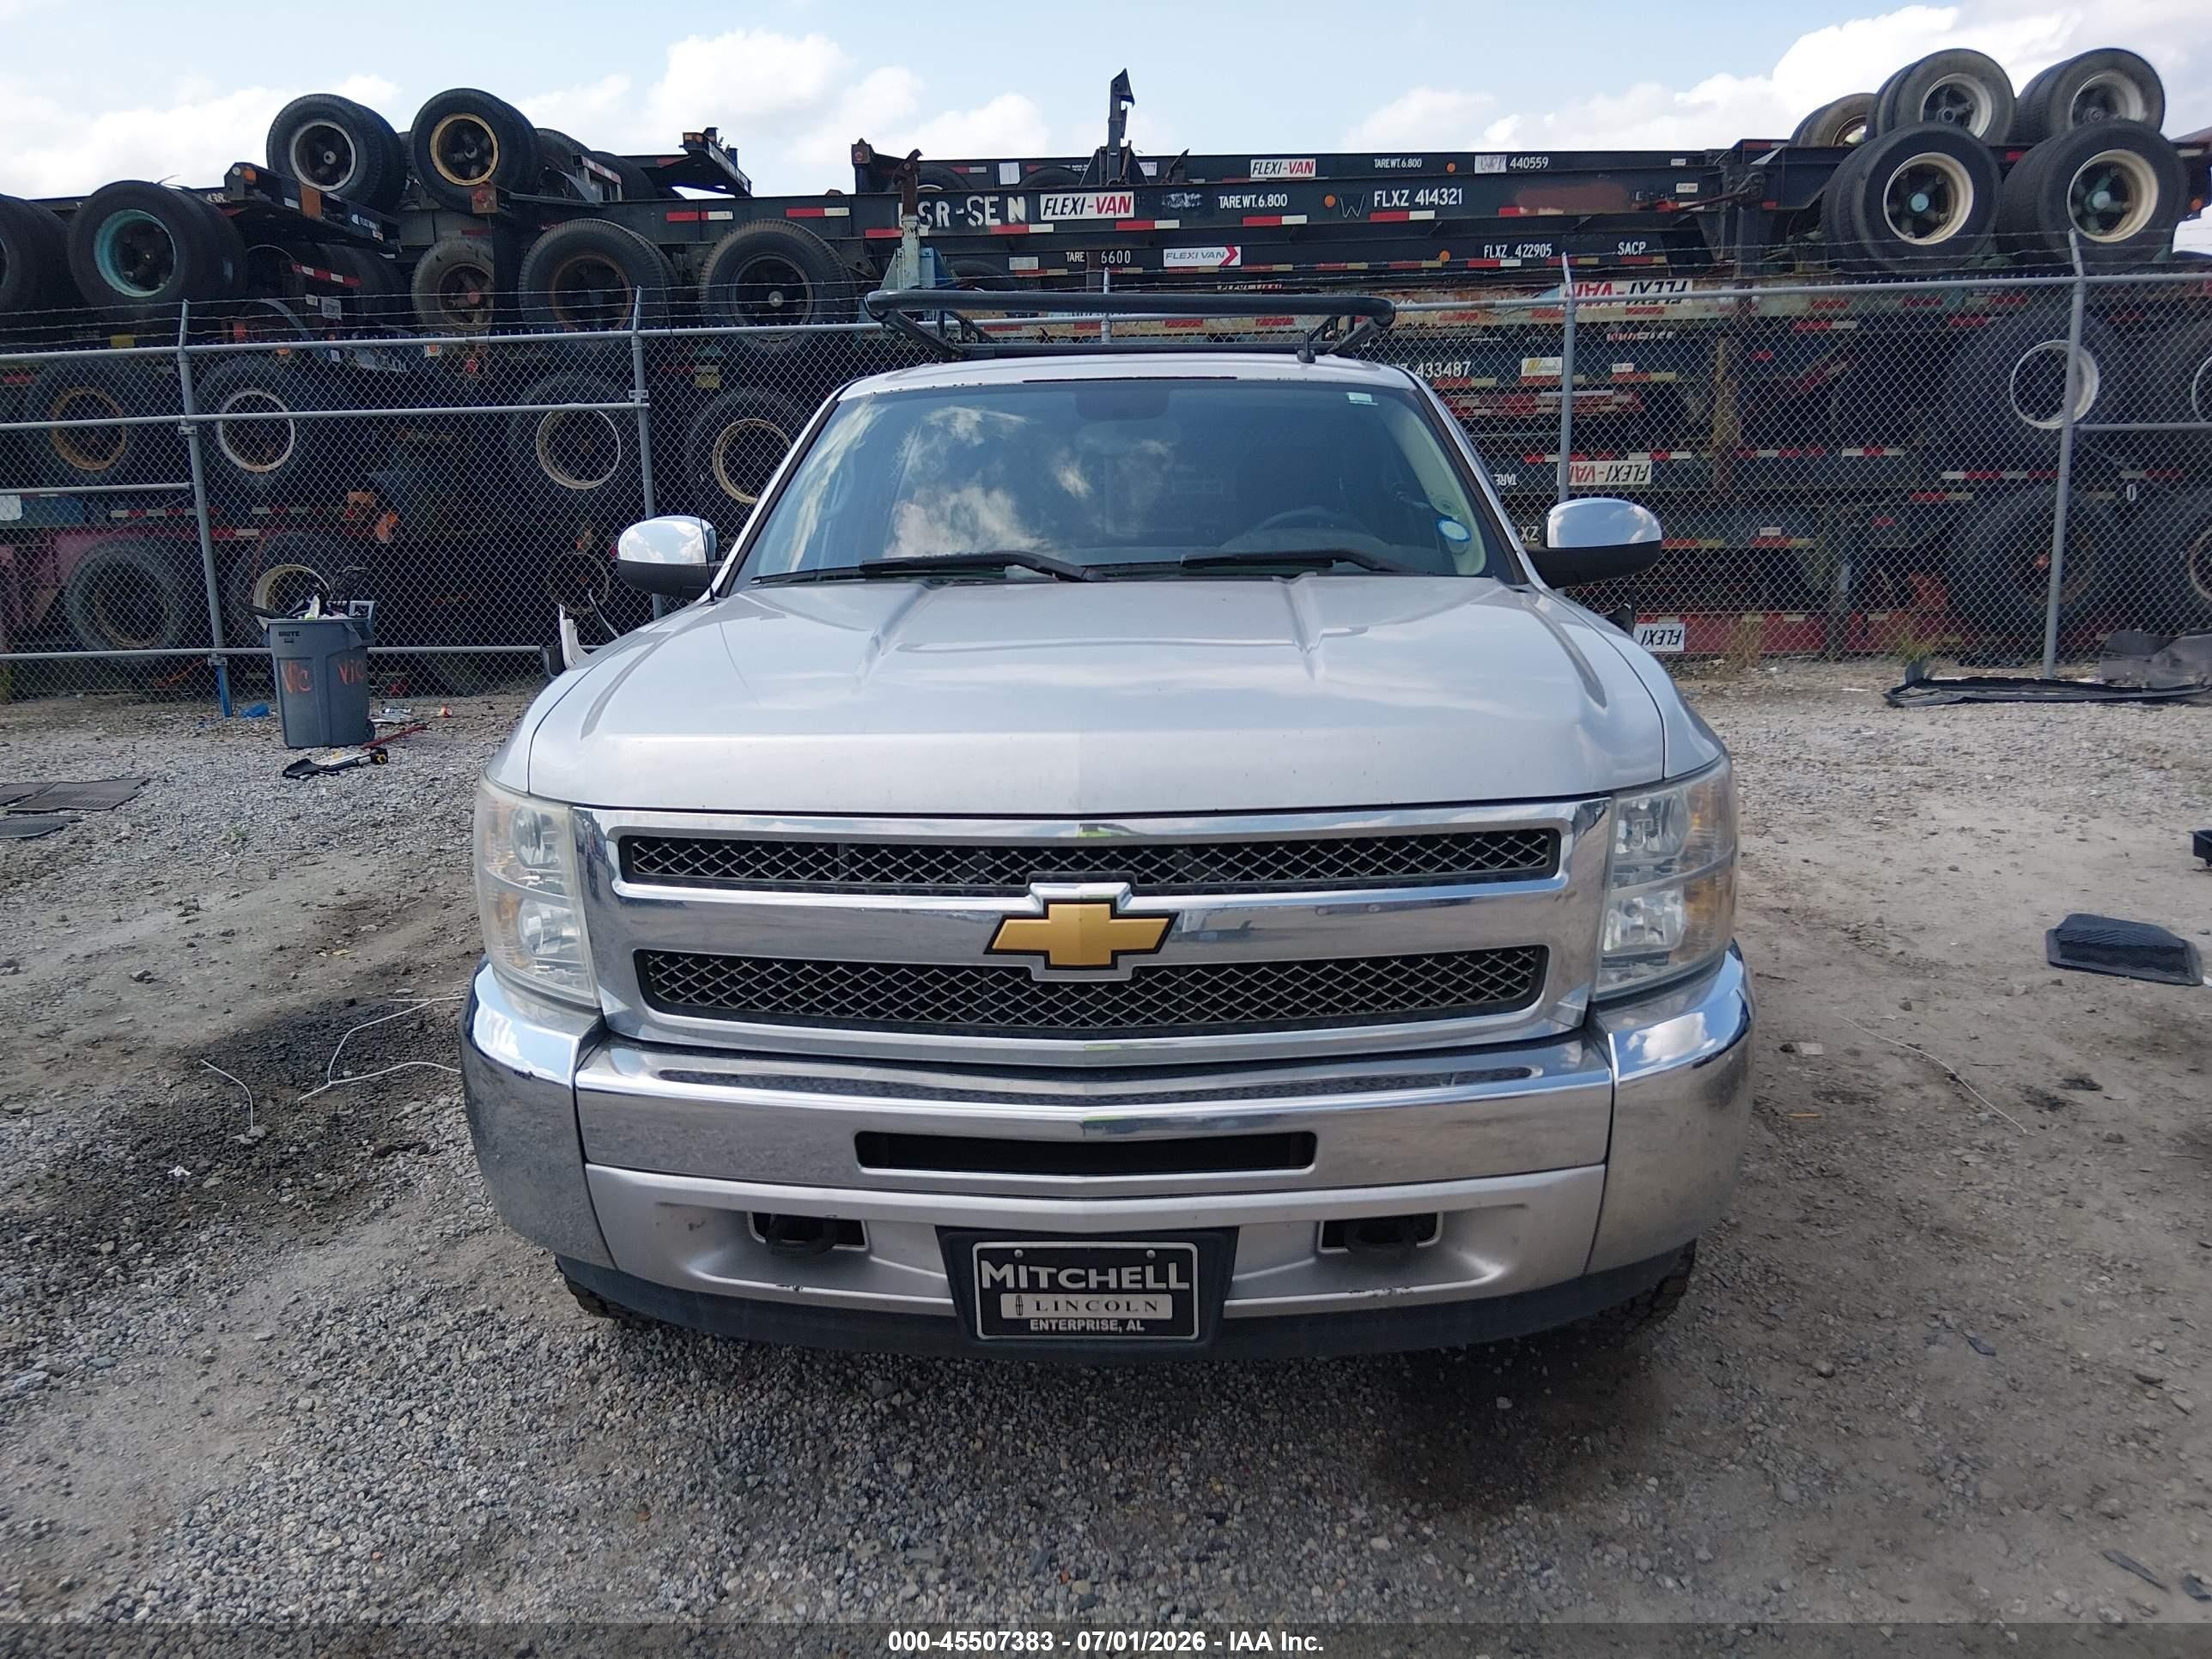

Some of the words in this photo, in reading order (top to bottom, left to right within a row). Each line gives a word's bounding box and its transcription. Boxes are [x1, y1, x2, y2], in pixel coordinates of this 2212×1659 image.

[1252, 161, 1314, 174] FLEXI-VAN
[1510, 156, 1549, 169] 440559
[1374, 189, 1410, 207] FLXZ
[1414, 187, 1463, 206] 414321
[1042, 195, 1132, 216] FLEXI-VAN
[1165, 252, 1199, 260] FLEXI
[1200, 251, 1225, 259] VAN
[1484, 244, 1507, 258] FLXZ
[1515, 243, 1553, 258] 422905
[1617, 241, 1647, 255] SACP
[1065, 251, 1085, 263] TARE
[1100, 250, 1132, 264] 6600
[1414, 362, 1471, 378] 433487
[1640, 629, 1682, 647] FLEXI
[981, 1260, 1190, 1290] MITCHELL
[1036, 1299, 1158, 1312] LINCOLN
[1030, 1319, 1123, 1334] ENTERPRISE,
[1126, 1319, 1146, 1331] AL
